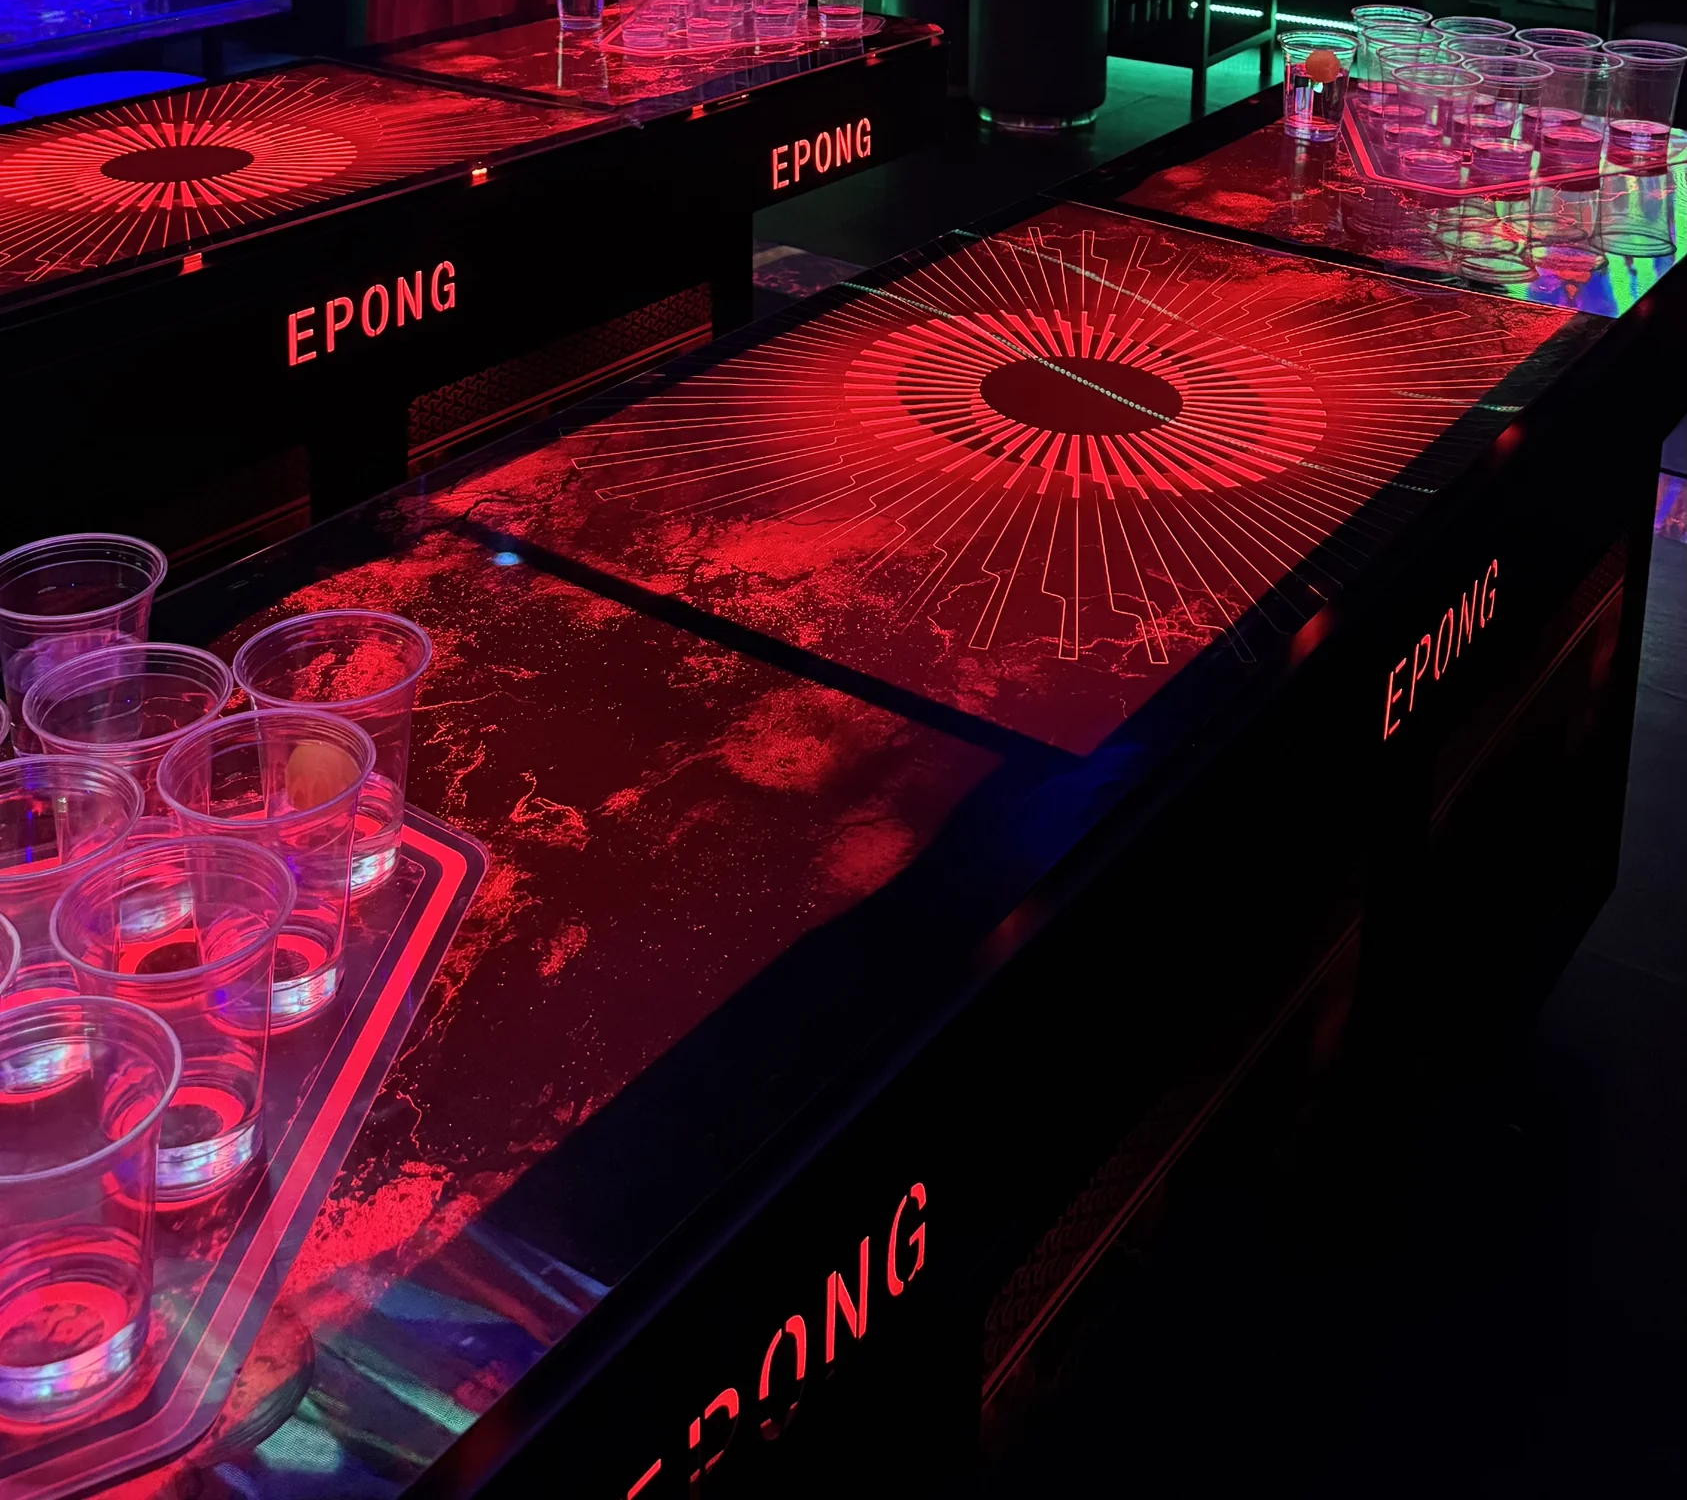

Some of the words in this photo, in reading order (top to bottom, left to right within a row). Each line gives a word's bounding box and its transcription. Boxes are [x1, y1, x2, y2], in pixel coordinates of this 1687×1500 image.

[771, 117, 872, 191] EPONG
[287, 260, 456, 367] EPONG
[1383, 558, 1498, 741] EPONG
[625, 1182, 927, 1500] PONG
